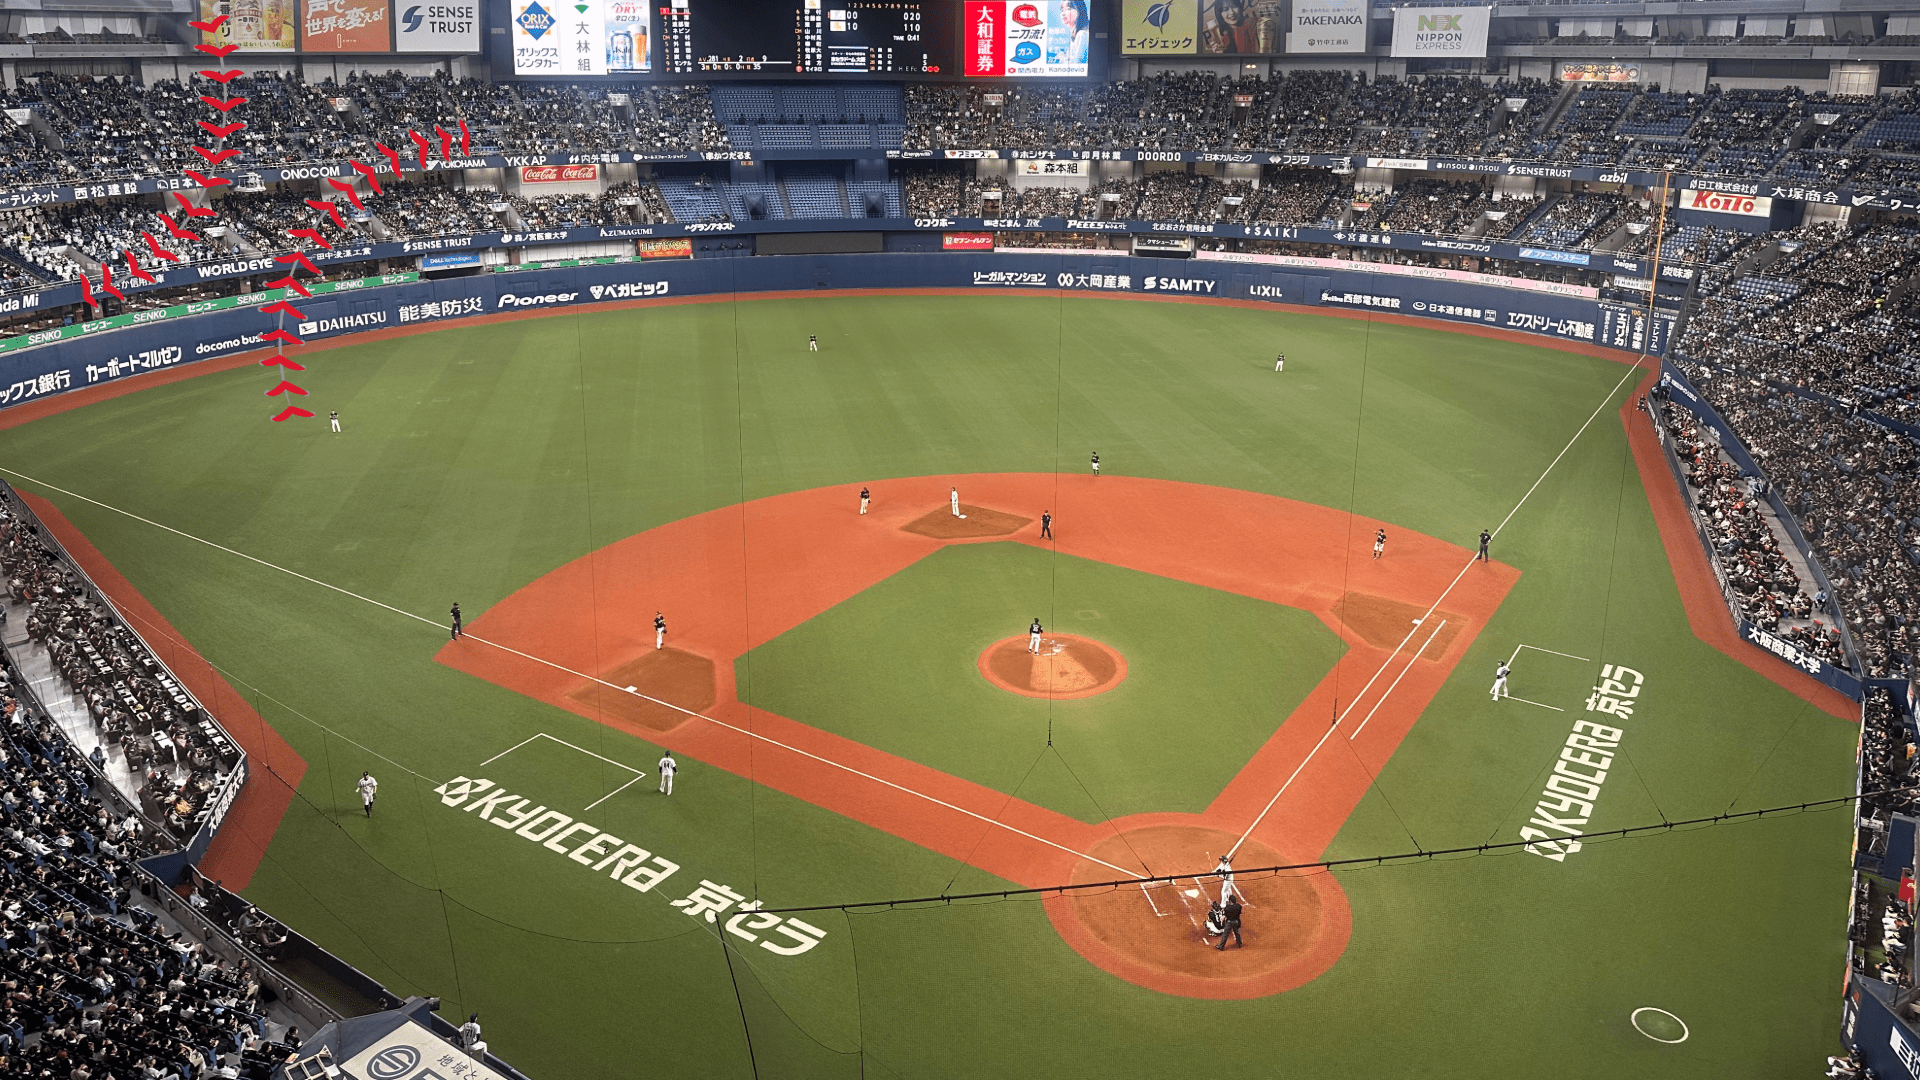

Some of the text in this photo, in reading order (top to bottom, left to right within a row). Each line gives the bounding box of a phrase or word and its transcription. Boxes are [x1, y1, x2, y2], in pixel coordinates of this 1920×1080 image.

[428, 6, 473, 18] SENSE
[615, 6, 639, 14] DRY
[521, 13, 550, 24] ORIX
[1297, 16, 1363, 25] TAKENAKA
[429, 21, 472, 33] TRUST
[977, 5, 994, 72] 大和証券
[1127, 37, 1193, 49] エイジェック
[1417, 33, 1462, 42] NIPPON
[517, 47, 558, 57] オリックス
[575, 21, 591, 71] 大林組
[1018, 48, 1034, 56] ガス
[1415, 42, 1461, 50] EXPRESS
[517, 59, 559, 68] レンタカー
[505, 155, 547, 166] YKK AP
[581, 153, 620, 163] 内外電機
[705, 151, 751, 160] 串かつだるま
[1020, 150, 1056, 159] ホシザキ
[1138, 152, 1181, 161] DOORDO
[1205, 153, 1252, 162] 日本カルミック
[1282, 155, 1310, 164] フジタ
[440, 158, 487, 169] YOKOHAMA
[1044, 162, 1078, 174] 森本組
[281, 165, 340, 180] ONOCOM
[1516, 165, 1572, 178] SENSE TRUST
[1600, 172, 1628, 183] azbil
[73, 182, 138, 200] 西松建設
[1698, 181, 1750, 194] 日工株式会社
[1771, 186, 1839, 204] 大塚商会
[922, 219, 956, 228] フクホー
[1152, 223, 1214, 233] 北おおさか信用金庫
[514, 231, 568, 243] 森ノ宮医療大学
[600, 228, 653, 237] AZUMAGUMI
[1254, 226, 1298, 239] SAIKI
[412, 237, 472, 250] SENSE TRUST
[198, 257, 274, 278] WORLD EYE
[1613, 259, 1637, 269] Daigas
[381, 273, 410, 284] センコー
[973, 271, 1047, 282] リーガルマンション
[1075, 274, 1131, 289] 大岡産業
[334, 279, 364, 290] SENKO
[1159, 277, 1216, 293] SAMTY
[1249, 285, 1283, 297] LIXIL
[236, 292, 266, 305] SENKO
[498, 291, 579, 307] Pioneer
[1343, 293, 1401, 309] 西部電気建設
[186, 301, 218, 313] センコー
[399, 296, 484, 322] 能美防災
[133, 309, 167, 323] SENKO
[319, 310, 387, 332] DAIHATSU
[81, 320, 113, 333] センコー
[1506, 312, 1595, 340] エクスドリーム不動産
[1613, 312, 1628, 347] エコリカ
[28, 329, 62, 345] SENKO
[196, 335, 240, 354] docomo
[86, 346, 182, 383] カーポートマルゼン
[1748, 626, 1821, 674] 大阪商業大学
[1585, 663, 1645, 720] 京セラ
[1530, 719, 1624, 836] KYOCERA
[463, 788, 680, 893] KYOCERA
[669, 879, 828, 956] 京セラ
